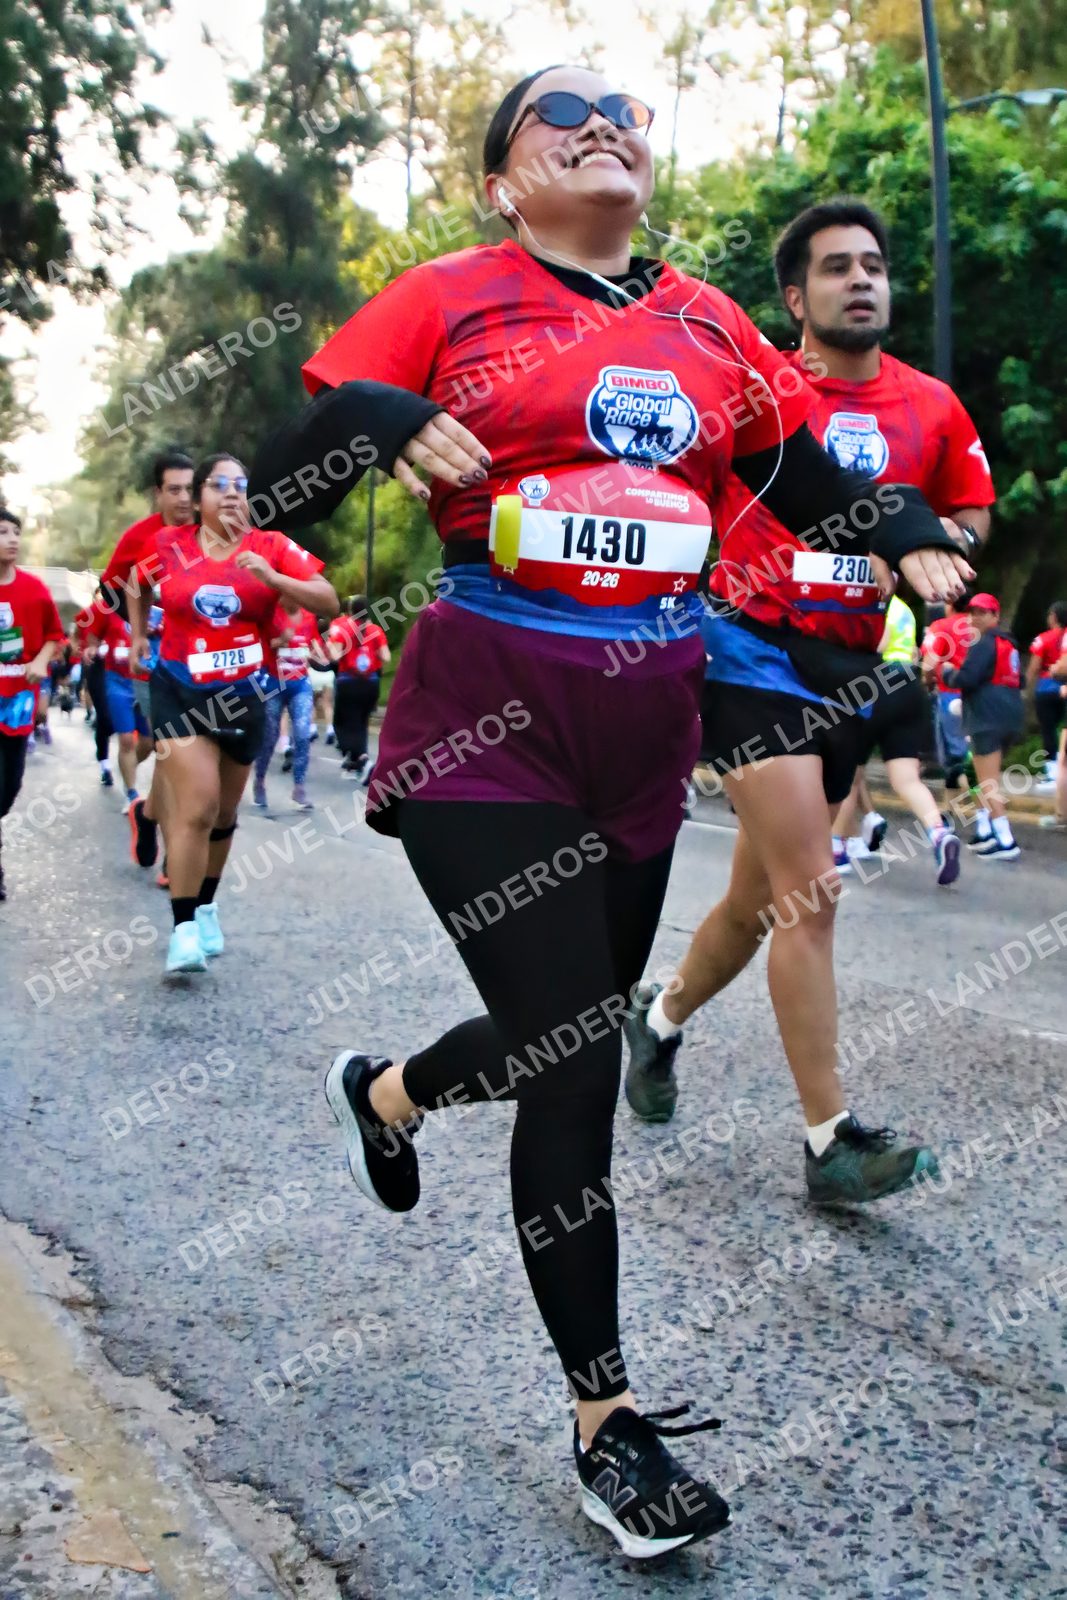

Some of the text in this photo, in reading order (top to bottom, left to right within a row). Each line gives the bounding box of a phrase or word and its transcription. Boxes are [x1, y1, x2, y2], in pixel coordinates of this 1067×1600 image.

[611, 375, 669, 391] BIMBO
[616, 394, 671, 415] Global
[604, 407, 652, 427] Race
[625, 487, 689, 502] COMPARTIMOS
[562, 516, 647, 565] 1430
[581, 570, 620, 588] 20-26
[659, 596, 676, 610] 5K
[212, 648, 246, 668] 2728
